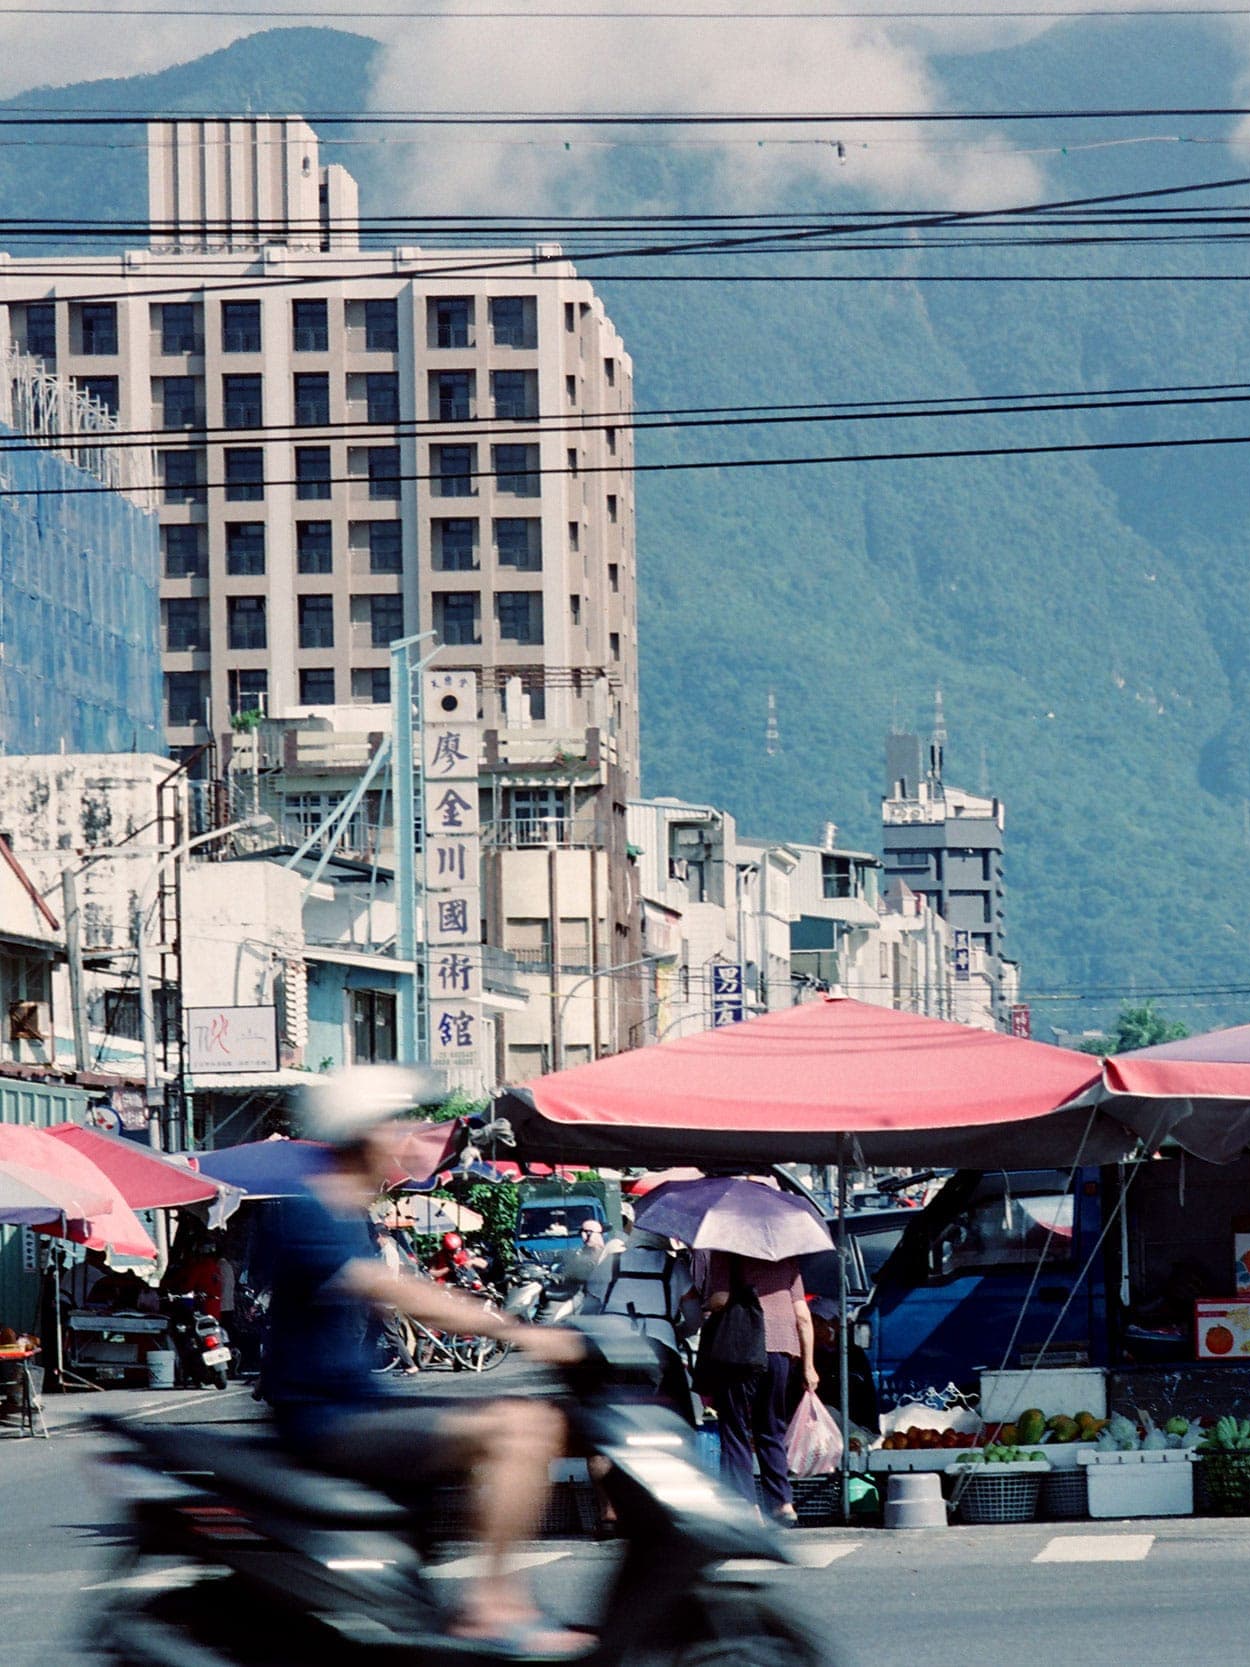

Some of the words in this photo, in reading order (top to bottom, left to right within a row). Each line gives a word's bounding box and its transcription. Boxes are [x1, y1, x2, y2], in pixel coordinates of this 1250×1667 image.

[430, 730, 476, 1048] 廖金川國術館
